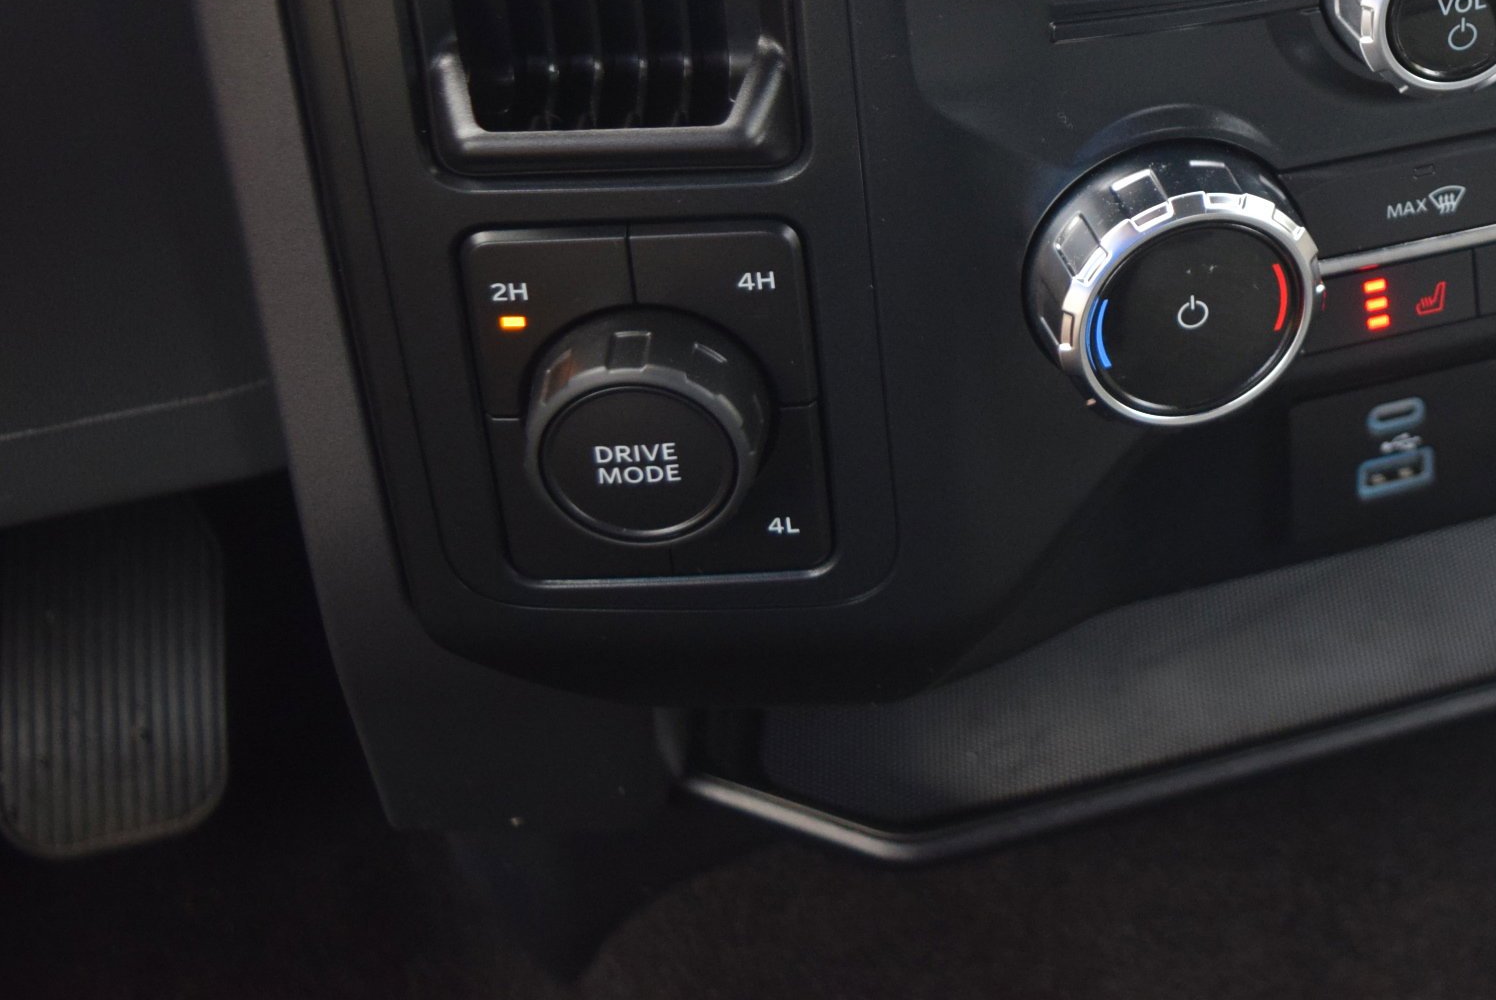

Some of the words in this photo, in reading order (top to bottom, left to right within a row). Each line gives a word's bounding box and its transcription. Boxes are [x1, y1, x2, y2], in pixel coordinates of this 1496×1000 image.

[1386, 198, 1428, 219] MAX
[737, 270, 776, 291] 4H
[490, 282, 529, 302] 2H
[594, 442, 679, 463] DRIVE
[597, 463, 682, 484] MODE
[768, 516, 800, 534] 4L
